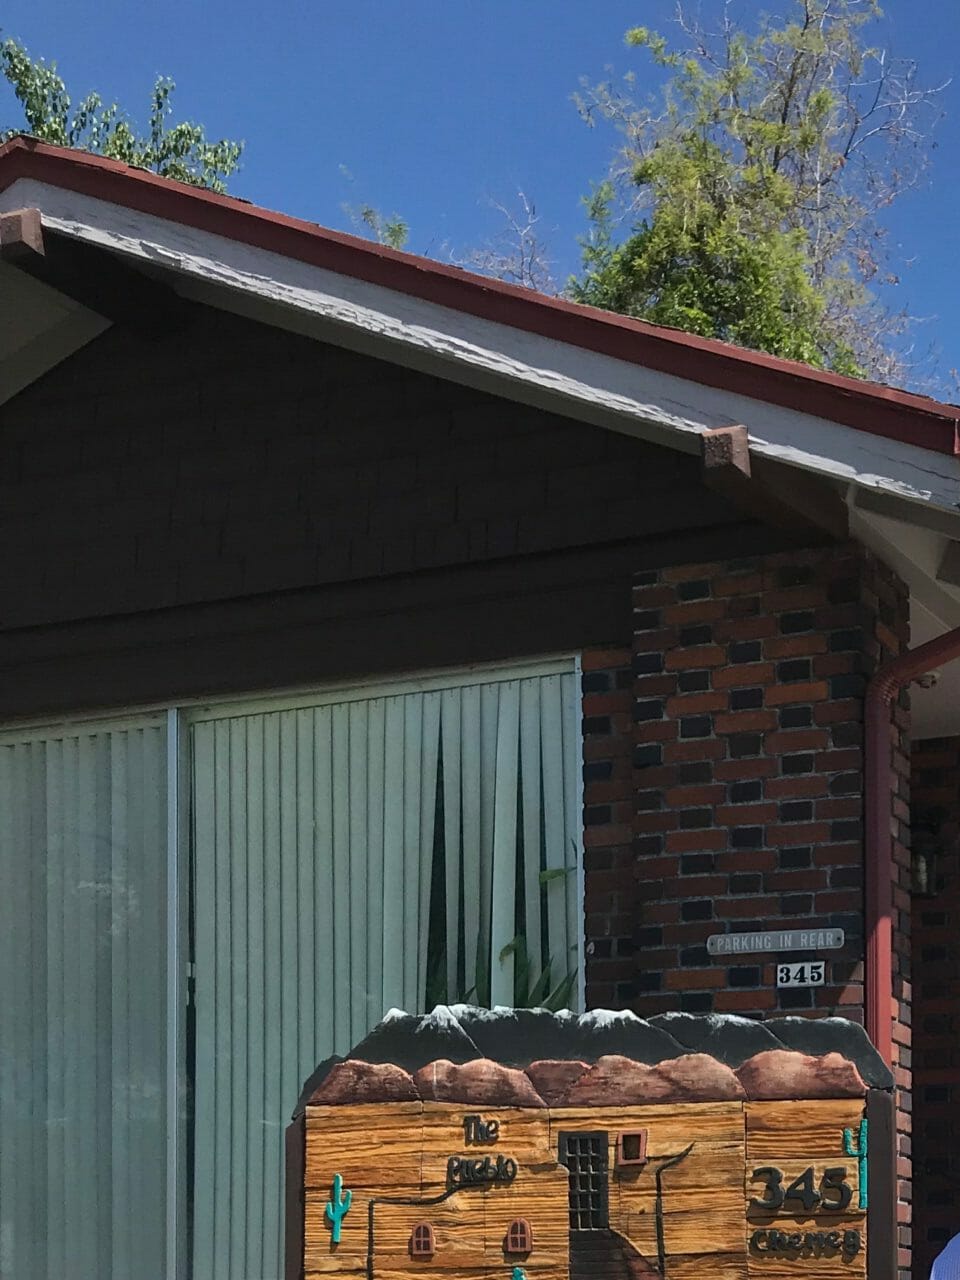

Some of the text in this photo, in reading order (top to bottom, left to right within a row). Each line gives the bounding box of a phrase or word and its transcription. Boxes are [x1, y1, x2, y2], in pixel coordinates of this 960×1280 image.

[717, 932, 833, 951] PARKING IN REAR
[779, 965, 822, 983] 345
[463, 1115, 500, 1147] The
[750, 1165, 853, 1210] 345
